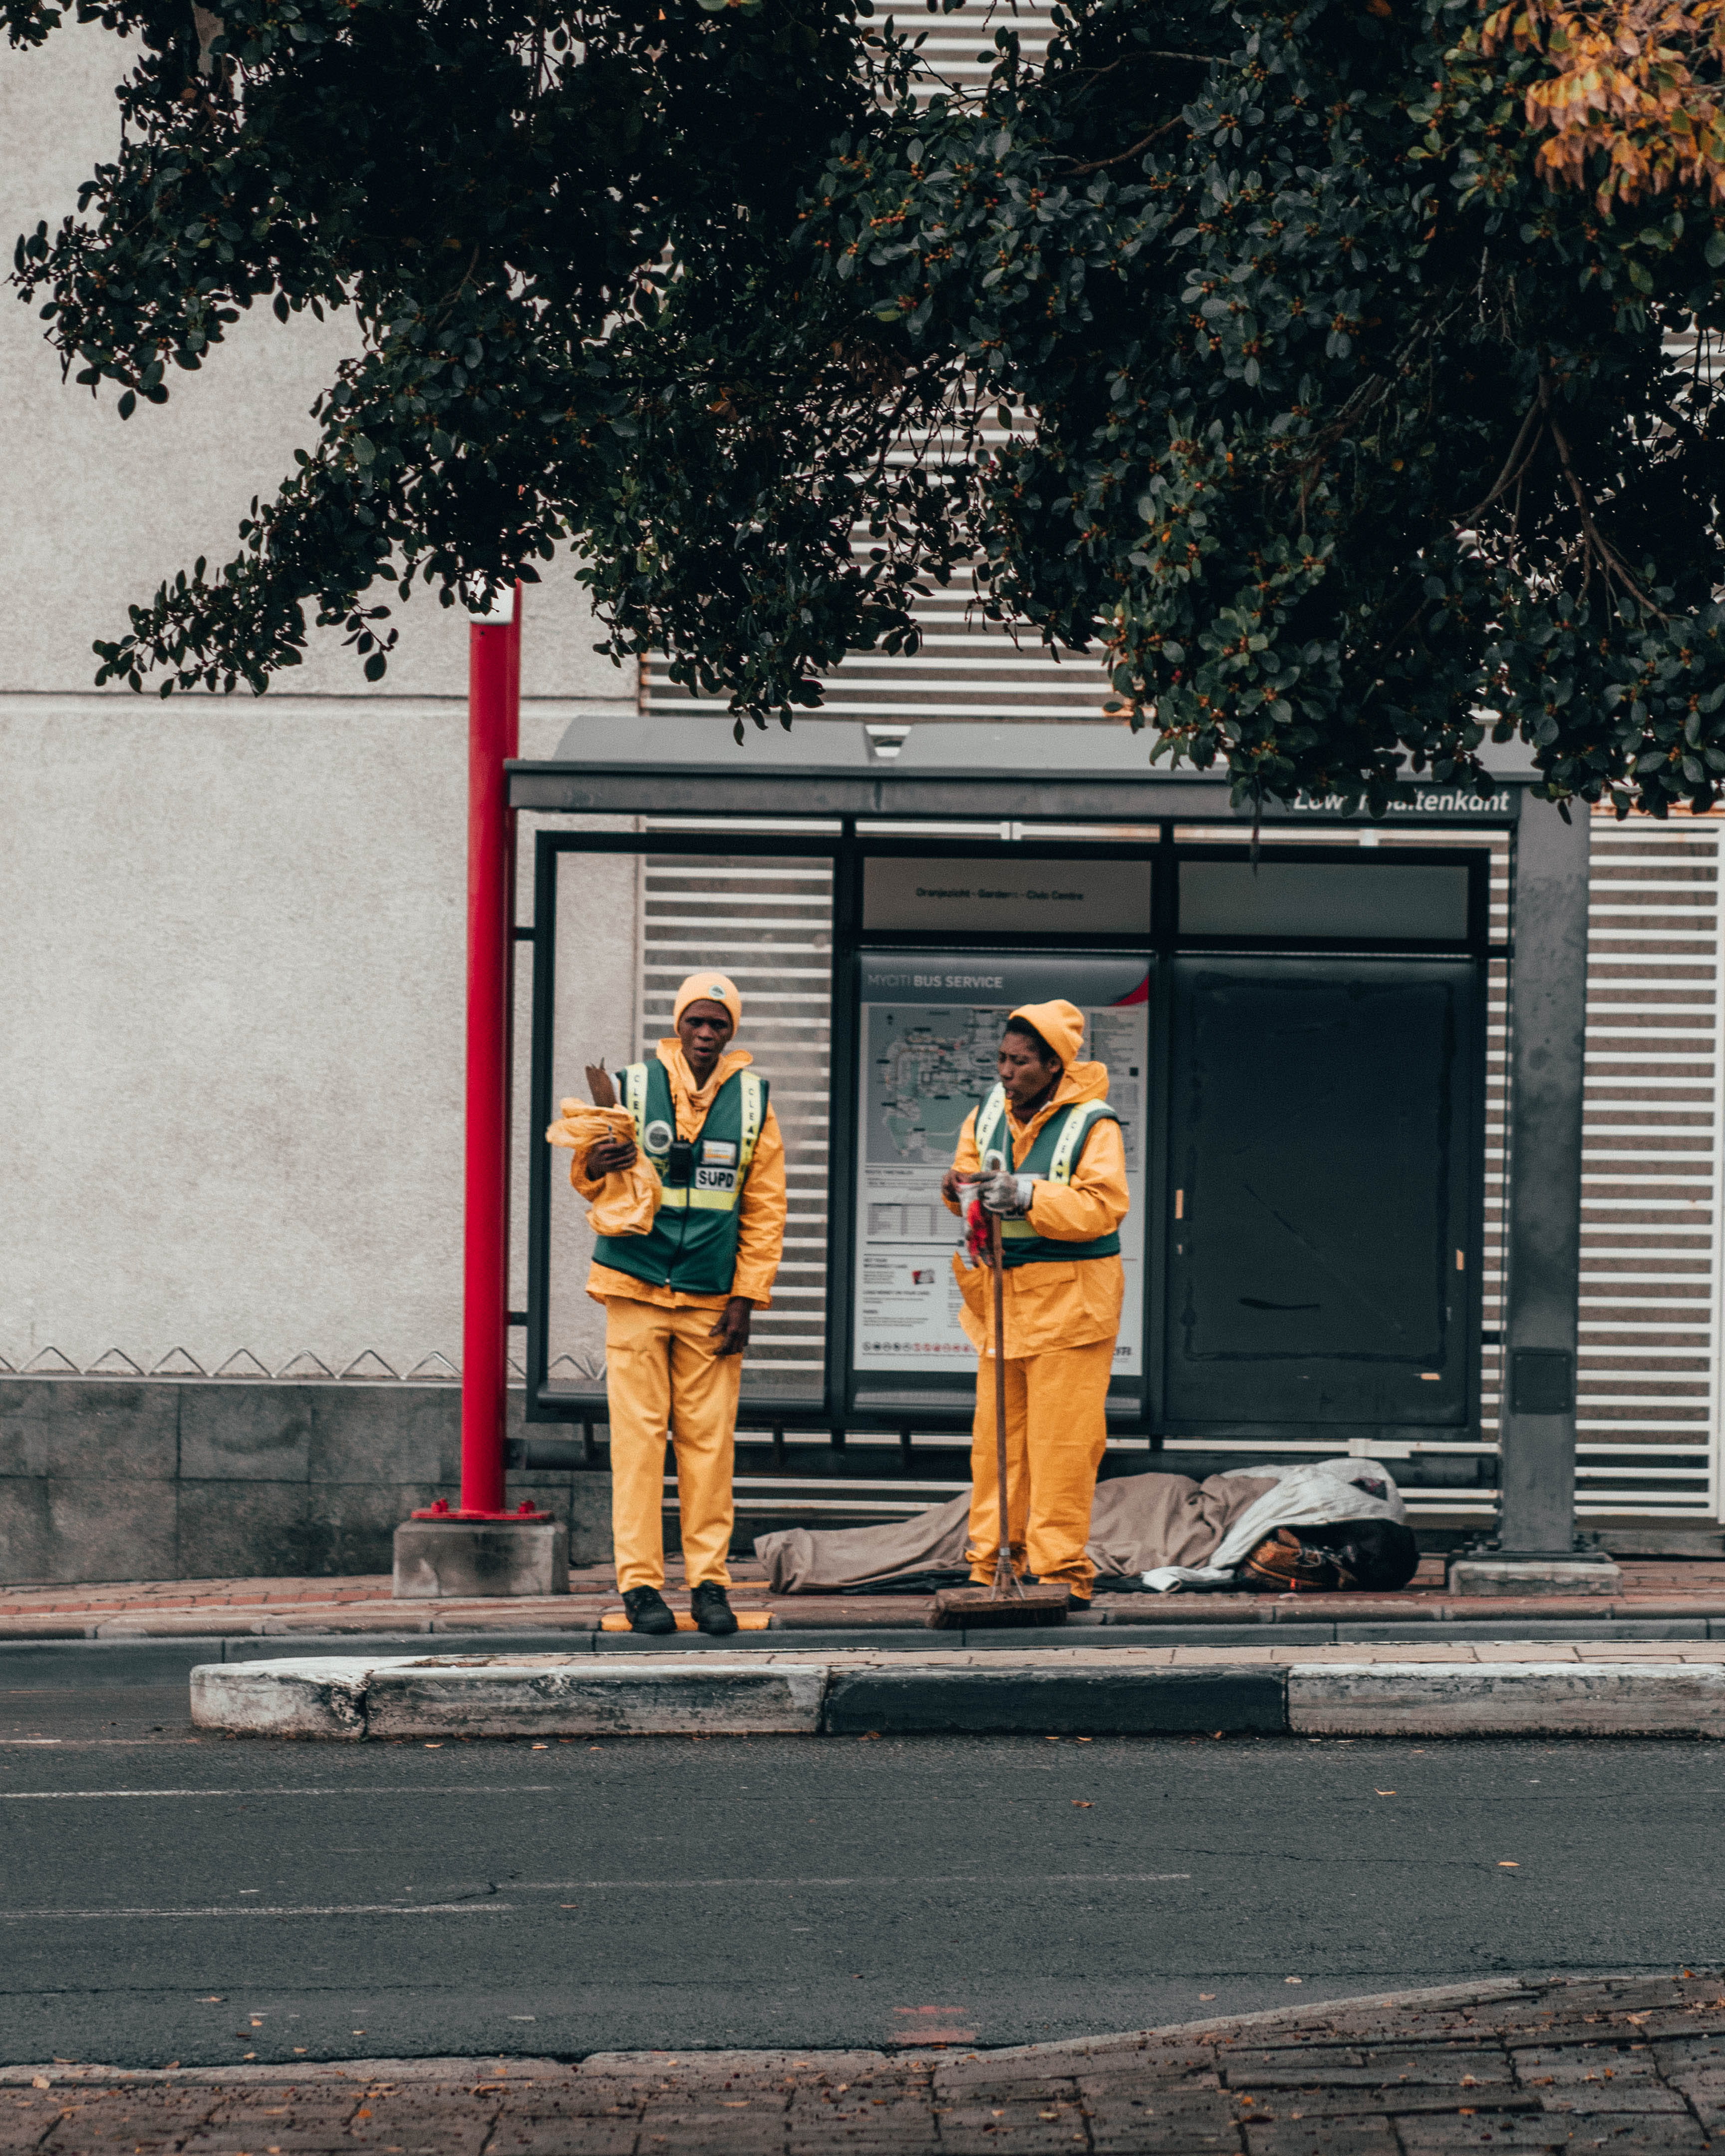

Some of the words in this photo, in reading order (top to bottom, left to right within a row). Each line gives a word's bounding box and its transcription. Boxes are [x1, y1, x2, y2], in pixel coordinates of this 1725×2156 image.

[1293, 788, 1369, 810] Lowr
[1382, 789, 1510, 811] utenkant
[913, 975, 942, 988] BUS
[945, 976, 1003, 989] SERVICE
[698, 1169, 734, 1188] SUPD
